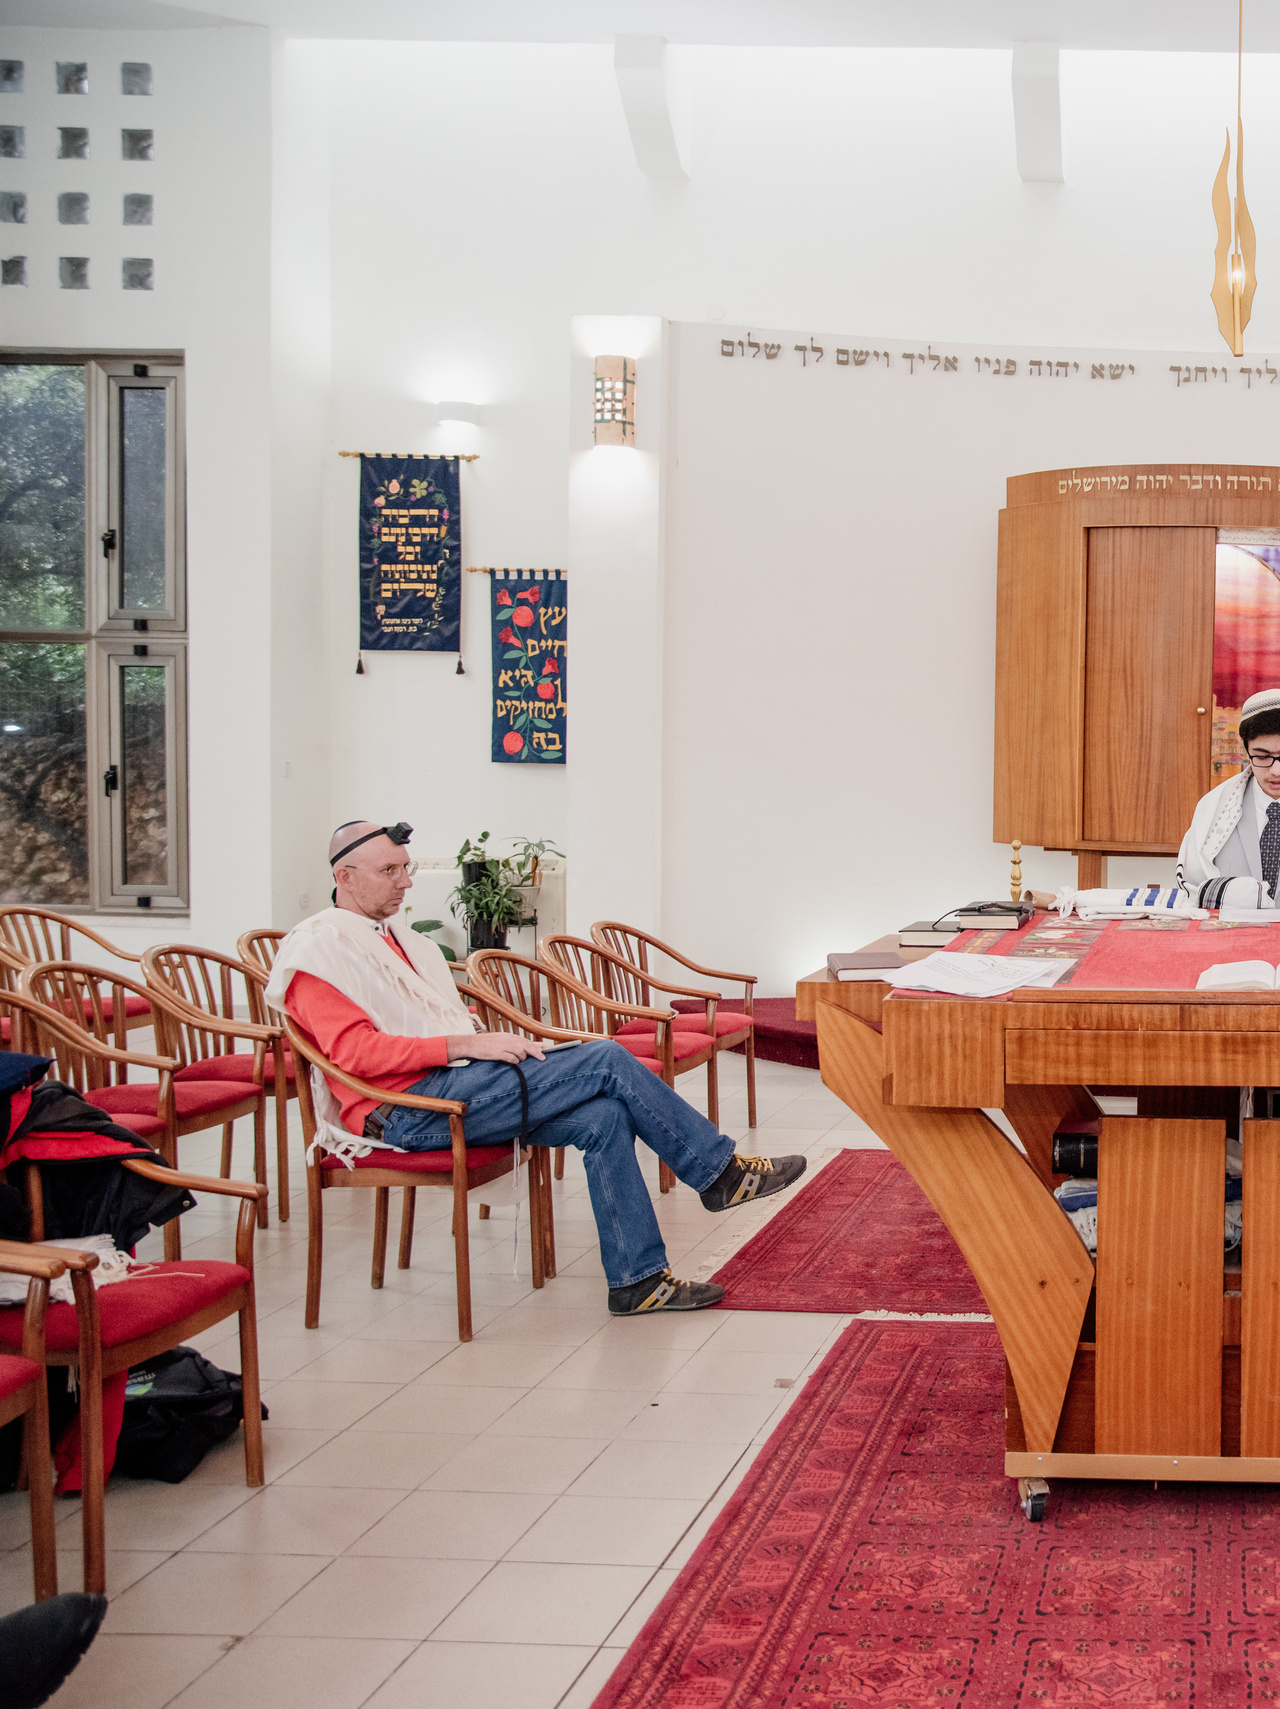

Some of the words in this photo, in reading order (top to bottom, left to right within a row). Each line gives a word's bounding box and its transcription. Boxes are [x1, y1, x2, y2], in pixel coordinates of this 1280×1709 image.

[720, 332, 781, 360] שלום
[794, 337, 824, 367] לך
[836, 347, 890, 367] וישם
[902, 345, 958, 375] אליך
[974, 356, 1017, 377] פניו
[1028, 359, 1080, 378] יהוה
[1090, 363, 1136, 381] ישא
[1169, 363, 1228, 388] ויחנך
[1058, 470, 1130, 495] מירושלים
[1136, 474, 1173, 490] יהוה
[1179, 474, 1222, 490] ודבר
[1226, 475, 1272, 491] תורה
[538, 606, 567, 635] עץ
[526, 638, 567, 658] חיים
[498, 668, 534, 688] היא
[496, 677, 567, 725] למחזיקים
[532, 731, 563, 751] בה
